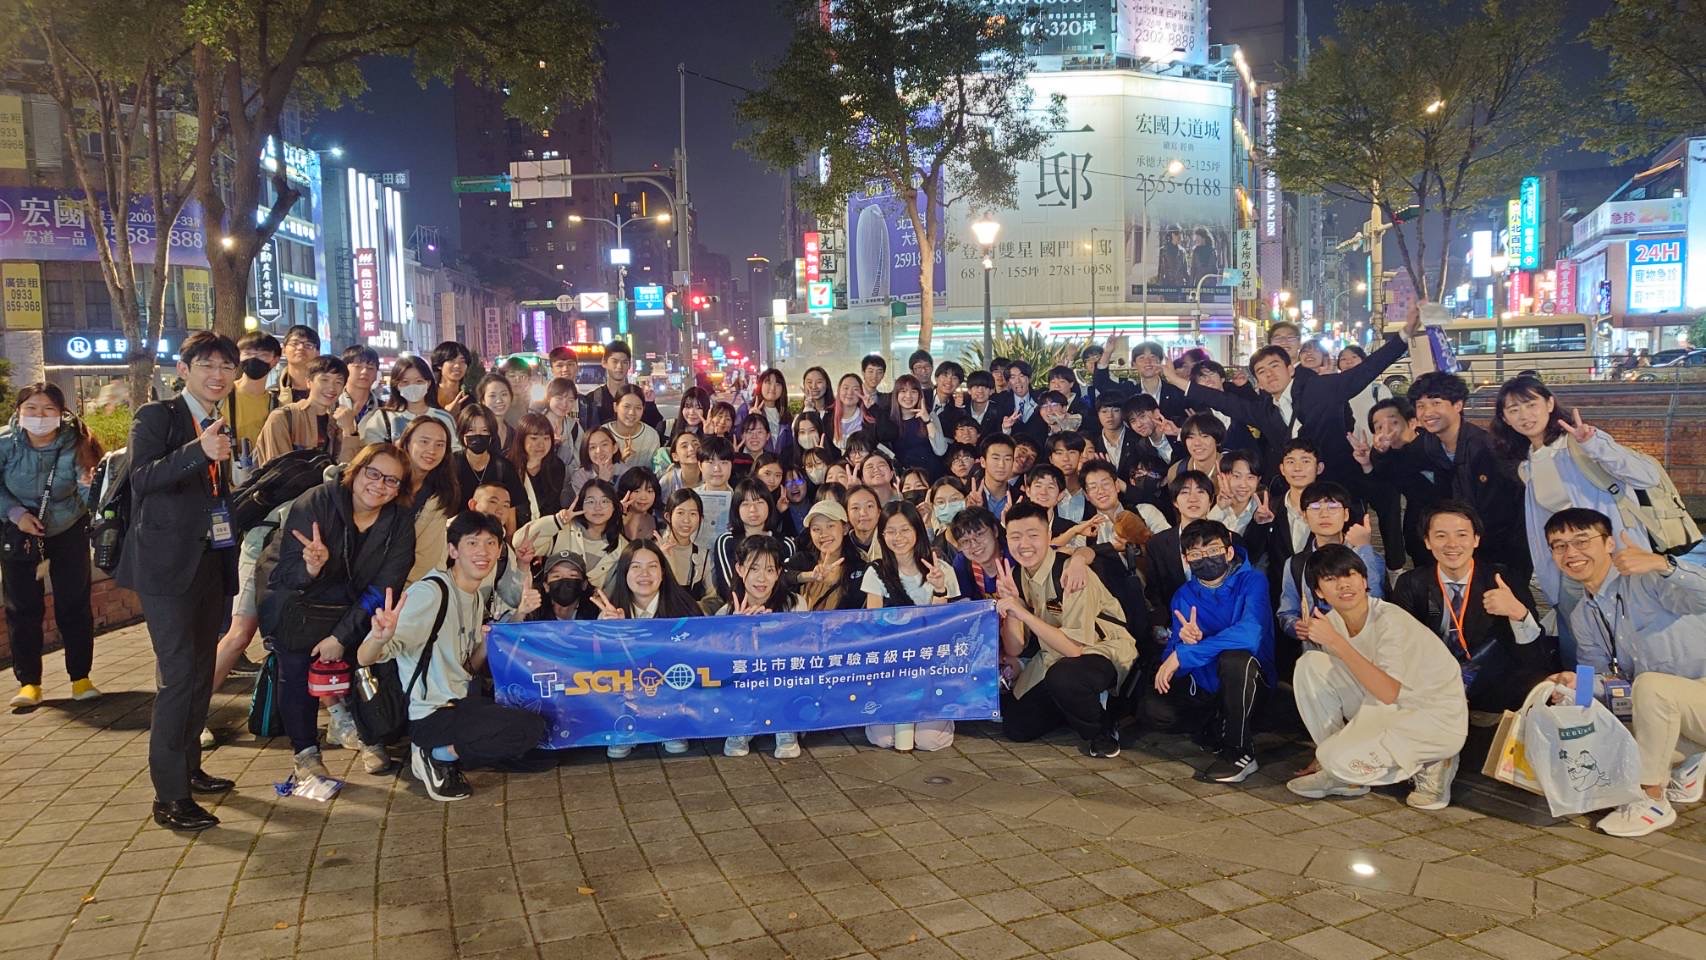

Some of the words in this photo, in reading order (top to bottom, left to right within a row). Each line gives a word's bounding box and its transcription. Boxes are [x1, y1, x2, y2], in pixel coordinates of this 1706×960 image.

[1136, 113, 1221, 141] 宏國大道城
[20, 197, 86, 230] 宏國
[23, 230, 87, 248] 宏道一品
[1635, 241, 1681, 263] 24H
[5, 277, 39, 289] 廣告租
[11, 289, 33, 300] 0933
[6, 300, 41, 313] 859-968
[732, 642, 969, 674] 臺北市數位實驗高級中等學校
[733, 677, 769, 691] Taipei
[773, 674, 814, 687] Digital
[818, 670, 896, 685] Experimental
[899, 666, 926, 678] High
[930, 663, 969, 675] School
